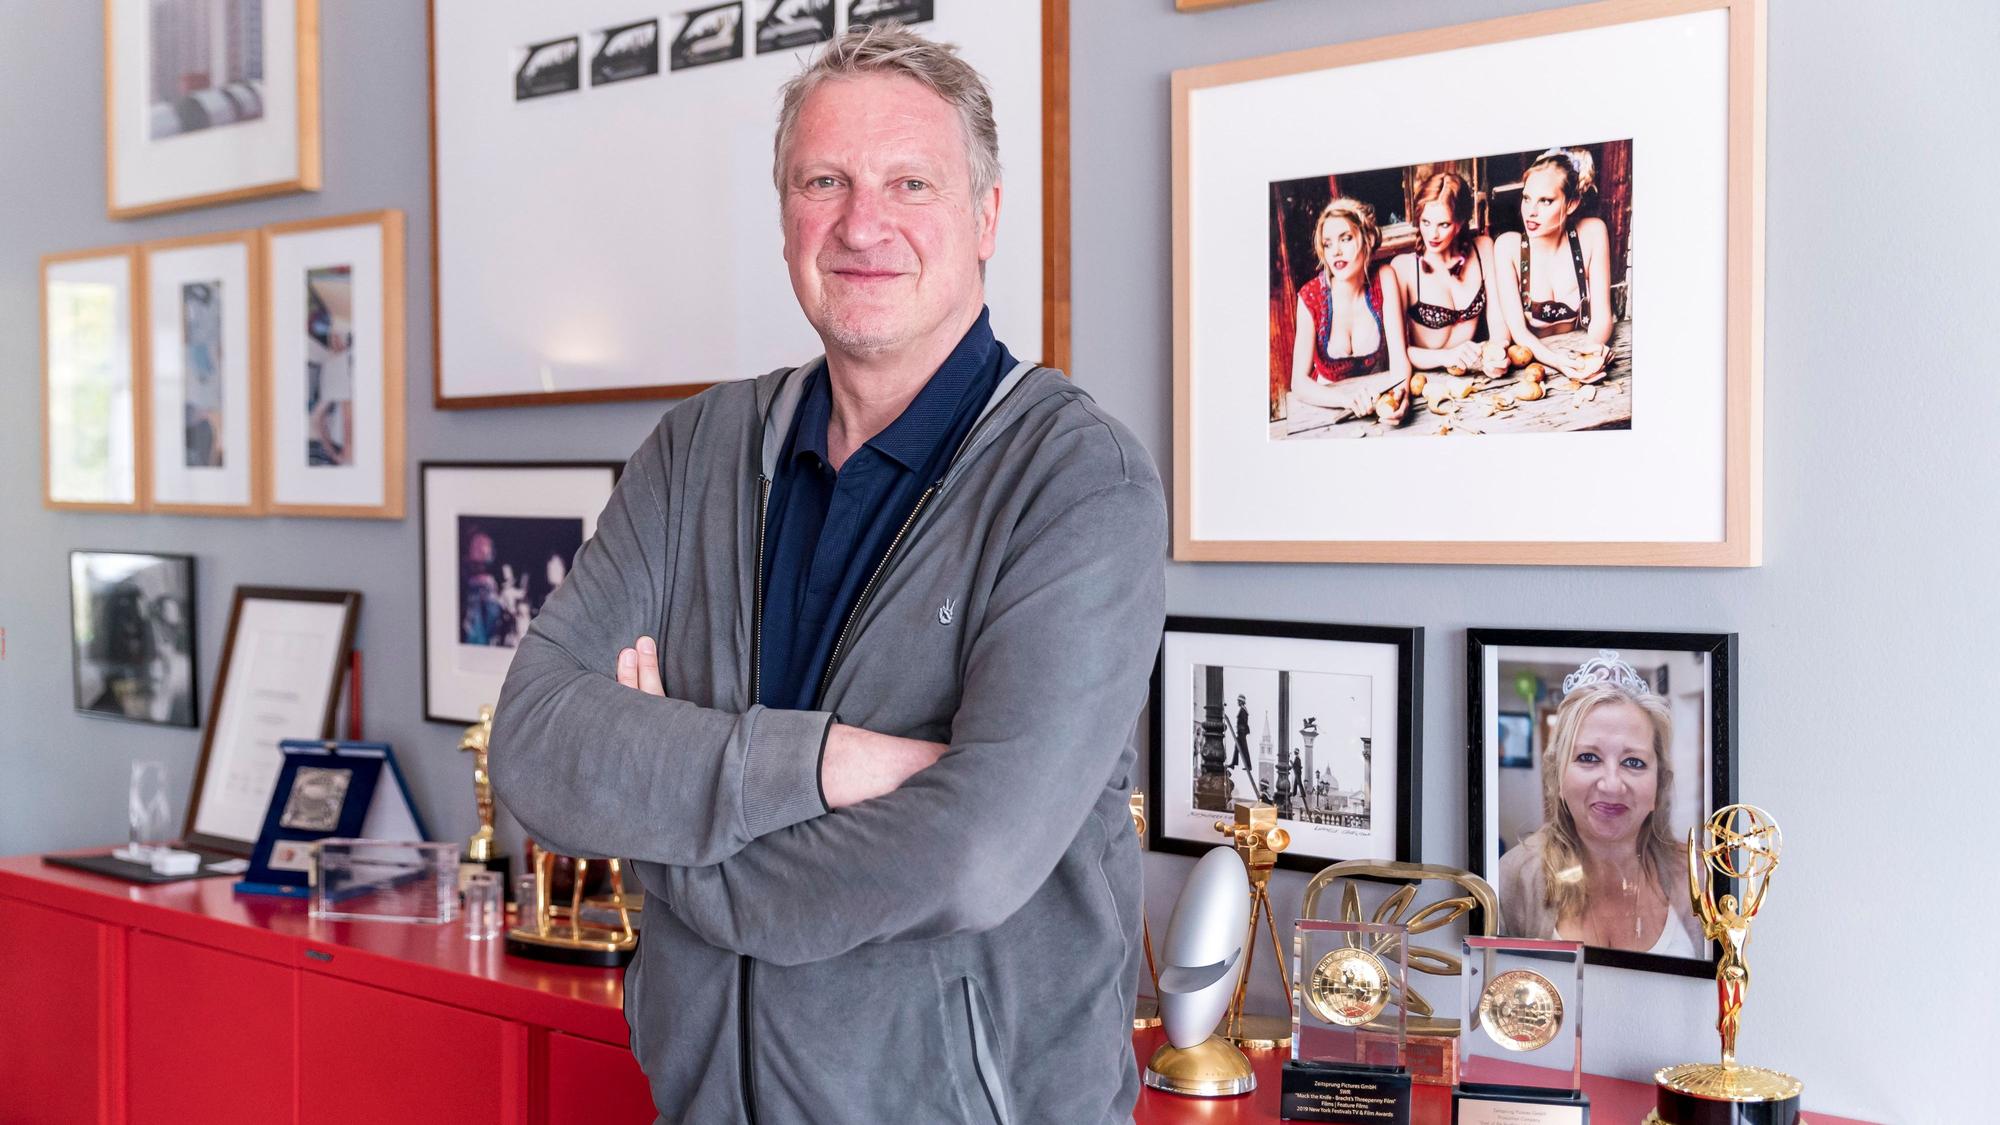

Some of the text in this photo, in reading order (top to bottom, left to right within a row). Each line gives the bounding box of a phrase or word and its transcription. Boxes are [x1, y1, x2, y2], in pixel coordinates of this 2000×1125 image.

[1314, 1080, 1340, 1089] Zeitsprung
[1354, 1096, 1383, 1104] Threepenny
[1375, 1110, 1394, 1118] Awards
